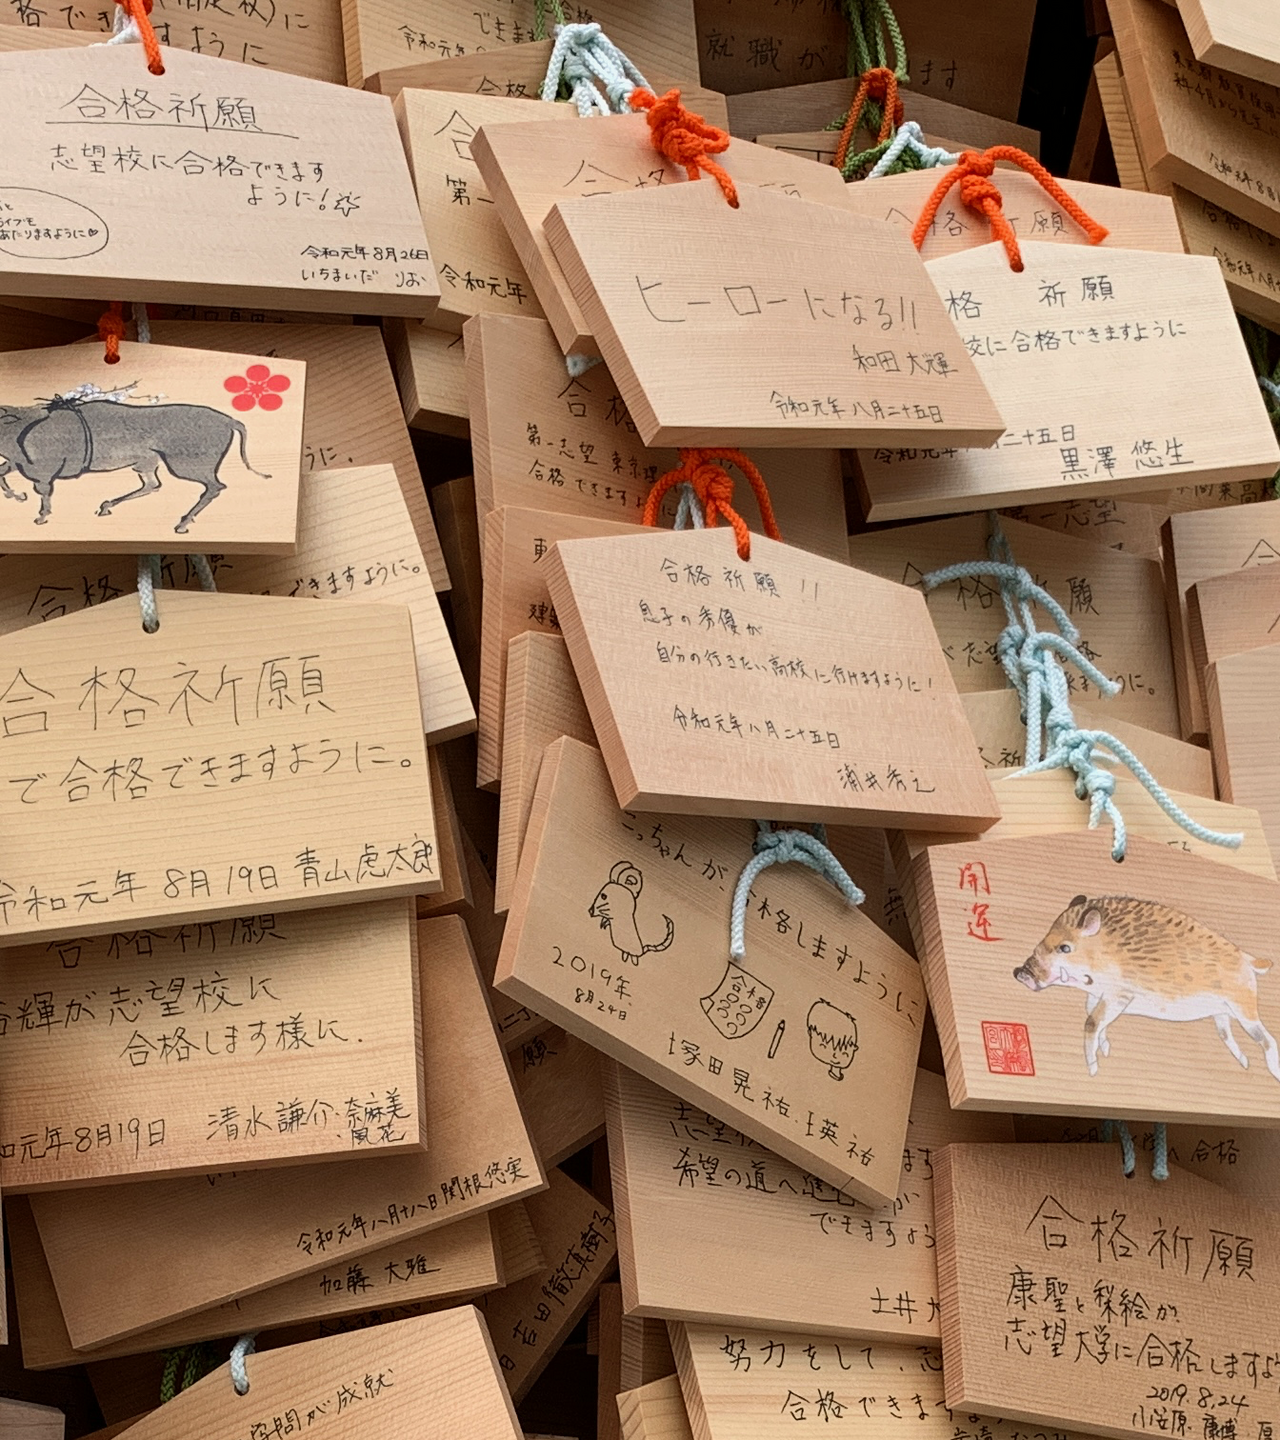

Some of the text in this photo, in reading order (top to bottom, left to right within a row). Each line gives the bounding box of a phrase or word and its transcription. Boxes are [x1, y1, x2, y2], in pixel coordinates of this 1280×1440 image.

[59, 84, 263, 133] 合格祈願
[50, 143, 324, 176] 志望校に合格できます
[300, 243, 430, 262] 令和元年8月26日
[636, 275, 919, 337] ヒーローになる!!
[769, 391, 943, 425] 令和元年八月二十五日
[673, 704, 842, 749] 令和元年八月二十五日
[957, 861, 1005, 943] 開運
[1024, 1194, 1256, 1284] 合格祈願
